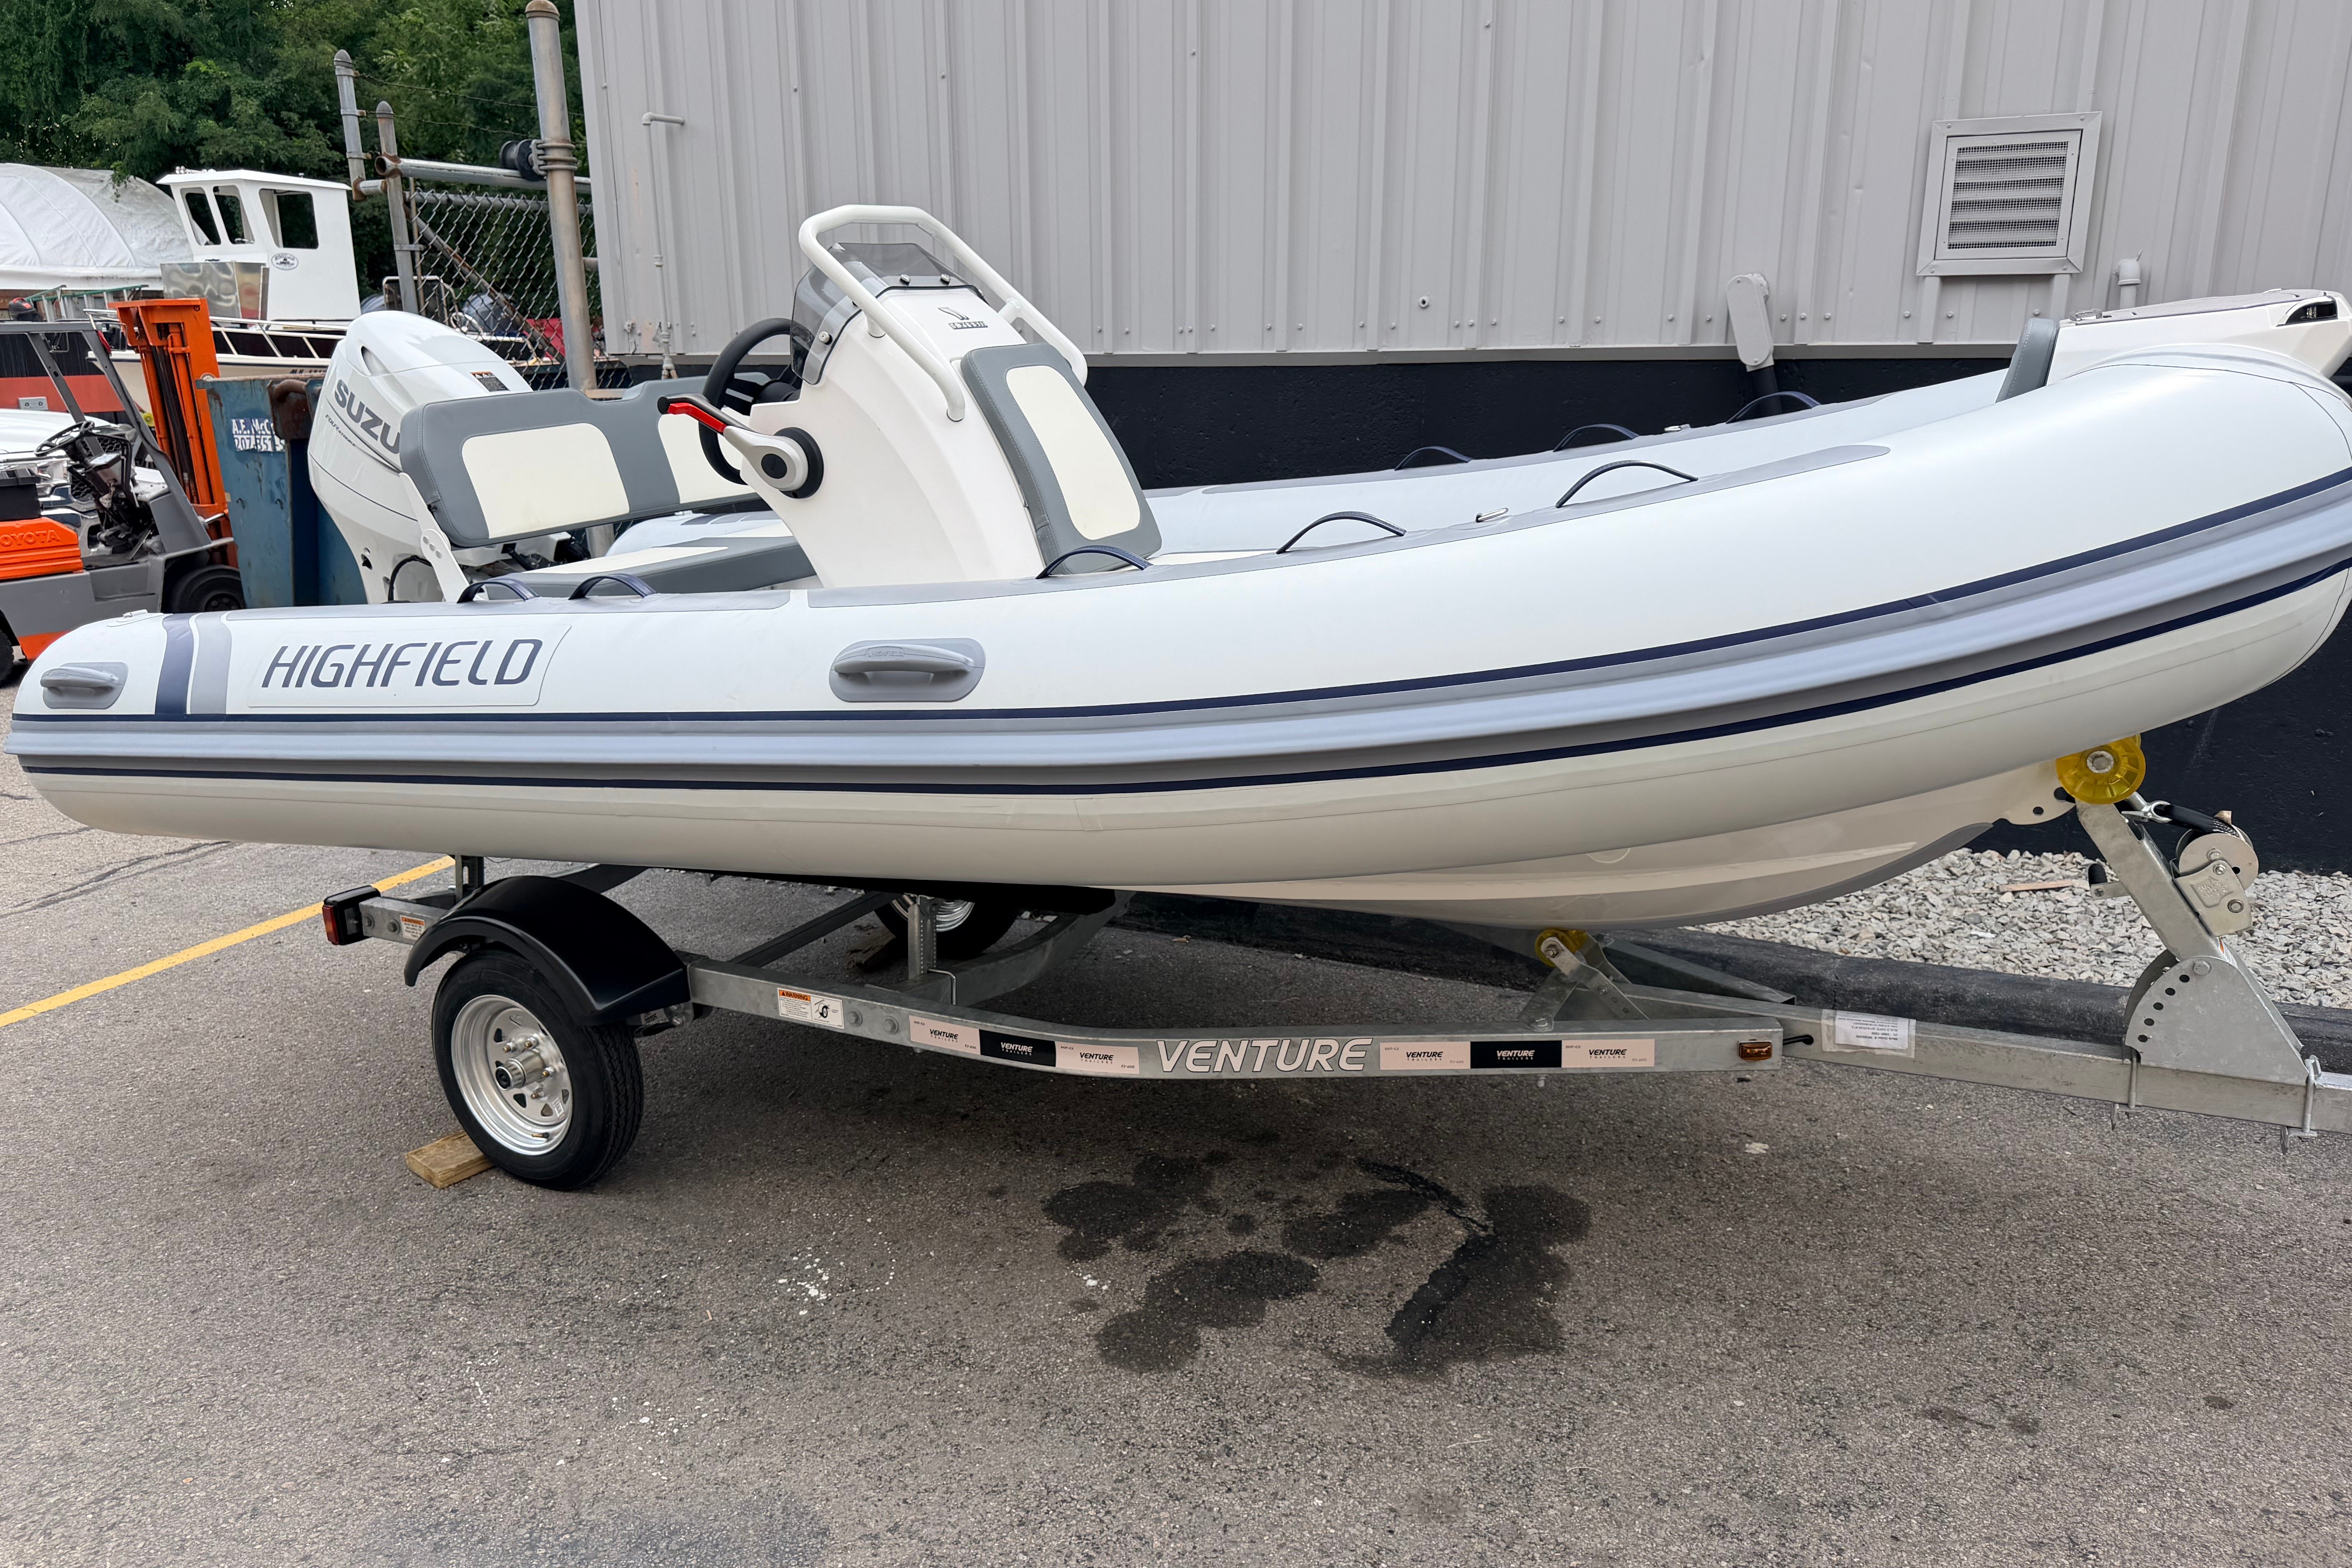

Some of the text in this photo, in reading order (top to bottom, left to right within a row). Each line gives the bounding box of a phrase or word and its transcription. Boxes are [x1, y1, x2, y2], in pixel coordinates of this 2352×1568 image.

[334, 379, 400, 454] SUZU
[261, 639, 543, 688] HIGHFIELD
[785, 992, 808, 1001] WARNING
[929, 1029, 959, 1040] VENTURE
[1001, 1042, 1033, 1053] VENTURE
[1079, 1052, 1114, 1061] VENTURE
[1157, 1037, 1373, 1072] VENTURE
